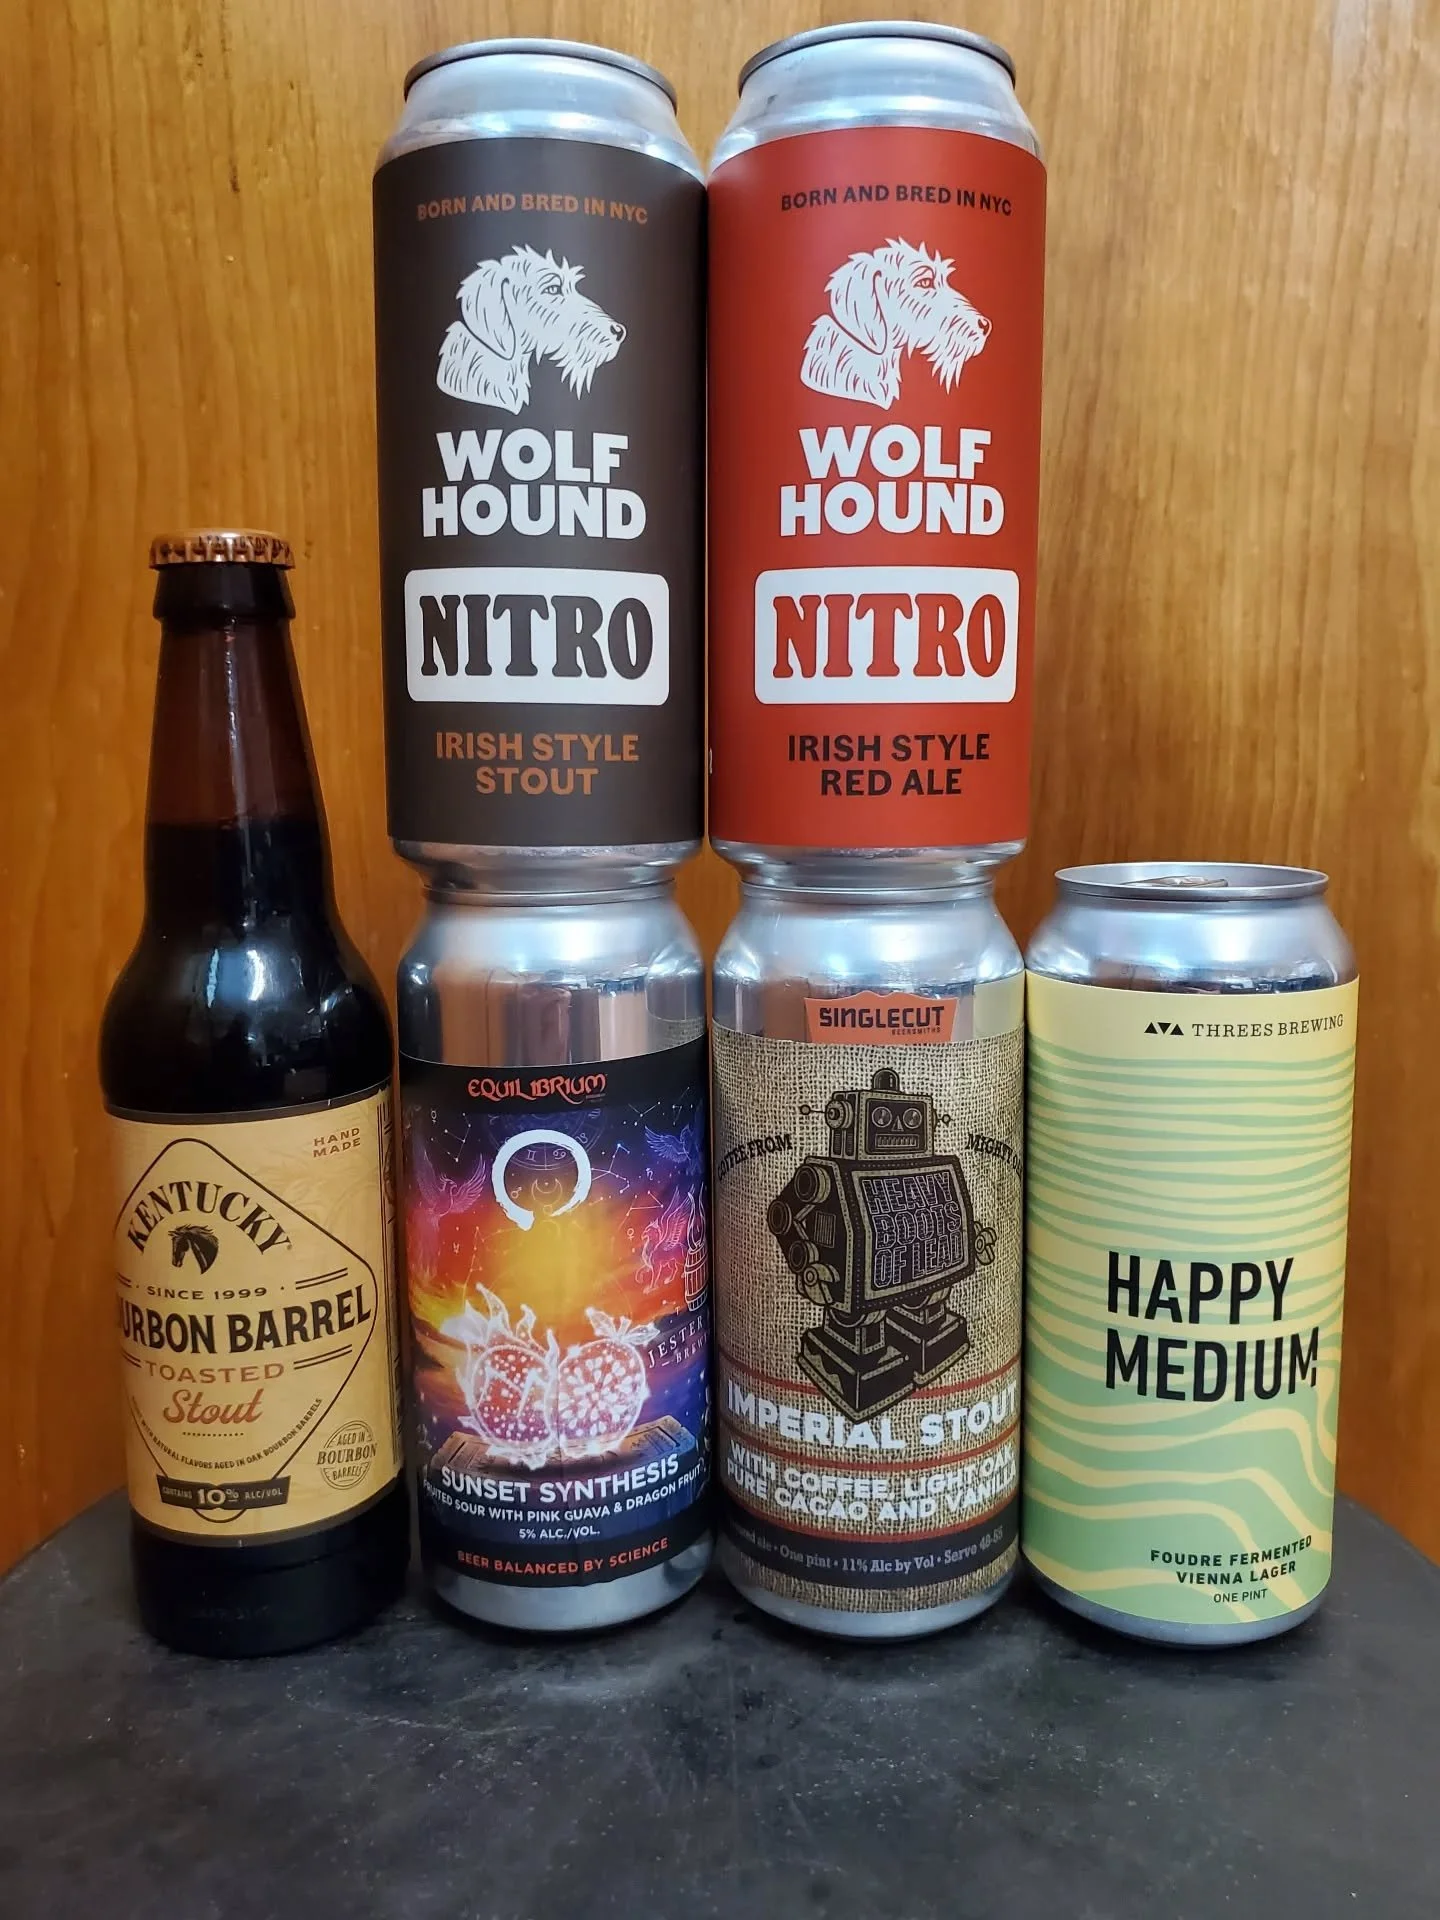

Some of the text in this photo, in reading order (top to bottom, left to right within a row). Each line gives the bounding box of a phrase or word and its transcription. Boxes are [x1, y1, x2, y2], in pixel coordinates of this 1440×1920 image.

[416, 193, 648, 224] BORN AND BRED IN NYC
[781, 184, 1012, 216] BORN AND BRED IN NYC
[436, 427, 628, 484] WOLF
[798, 424, 992, 480] WOLF
[423, 483, 646, 540] HOUND
[780, 482, 1004, 536] HOUND
[419, 594, 653, 680] NITRO
[772, 593, 1006, 679] NITRO
[436, 732, 639, 762] IRISH STYLE
[787, 733, 990, 763] IRISH STYLE
[476, 768, 599, 795] STOUT
[820, 768, 963, 796] RED ALE
[820, 1006, 944, 1028] SINGLECUT
[1192, 1014, 1344, 1038] THREES BREWING
[468, 1073, 606, 1105] EQUILIBRIUM
[312, 1137, 361, 1158] MADE
[313, 1127, 360, 1146] HAND
[747, 1134, 793, 1158] FROM
[862, 1171, 953, 1215] HEAVY
[127, 1180, 291, 1255] KENTUCKY
[872, 1201, 962, 1250] BOOTS
[874, 1231, 963, 1288] OF LEAD
[146, 1285, 268, 1301] SINCE 1999
[1107, 1251, 1295, 1324] HAPPY
[227, 1284, 372, 1353] BARREL
[648, 1315, 703, 1368] JESTER
[145, 1360, 285, 1384] TOASTED
[1106, 1326, 1319, 1402] MEDIUM
[163, 1388, 264, 1425] Stout
[728, 1380, 1017, 1450] IMPERIAL STOUT
[180, 1455, 213, 1469] FLAVORS
[214, 1461, 235, 1470] AGED
[237, 1460, 245, 1468] IN
[247, 1453, 263, 1464] OAK
[263, 1429, 299, 1457] BOURBON
[297, 1397, 322, 1431] BARRELS
[337, 1432, 357, 1446] AGED
[317, 1444, 376, 1465] BOURBON
[730, 1440, 776, 1480] WITH
[904, 1464, 977, 1497] LIGHT
[332, 1466, 363, 1481] BARRELS
[441, 1453, 679, 1503] SUNSET SYNTHESIS
[727, 1457, 1016, 1521] PURE CACAO AND VANILLA
[197, 1488, 240, 1505] 10%
[245, 1486, 283, 1500] ALC/VOL
[423, 1463, 701, 1522] FRUITED SOUR WITH PINK GUAVA & DRAGON FRUIT
[519, 1528, 536, 1539] 5%
[457, 1537, 669, 1574] BEER BALANCED BY SCIENCE
[780, 1544, 804, 1562] One
[806, 1554, 831, 1568] pint
[842, 1558, 868, 1573] 11%
[870, 1558, 893, 1573] Alc
[895, 1557, 912, 1575] by
[914, 1554, 935, 1570] Vol
[1150, 1535, 1312, 1567] FOUDRE FERMENTED
[1176, 1561, 1296, 1585] VIENNA LAGER
[1213, 1588, 1268, 1603] ONE PINT
